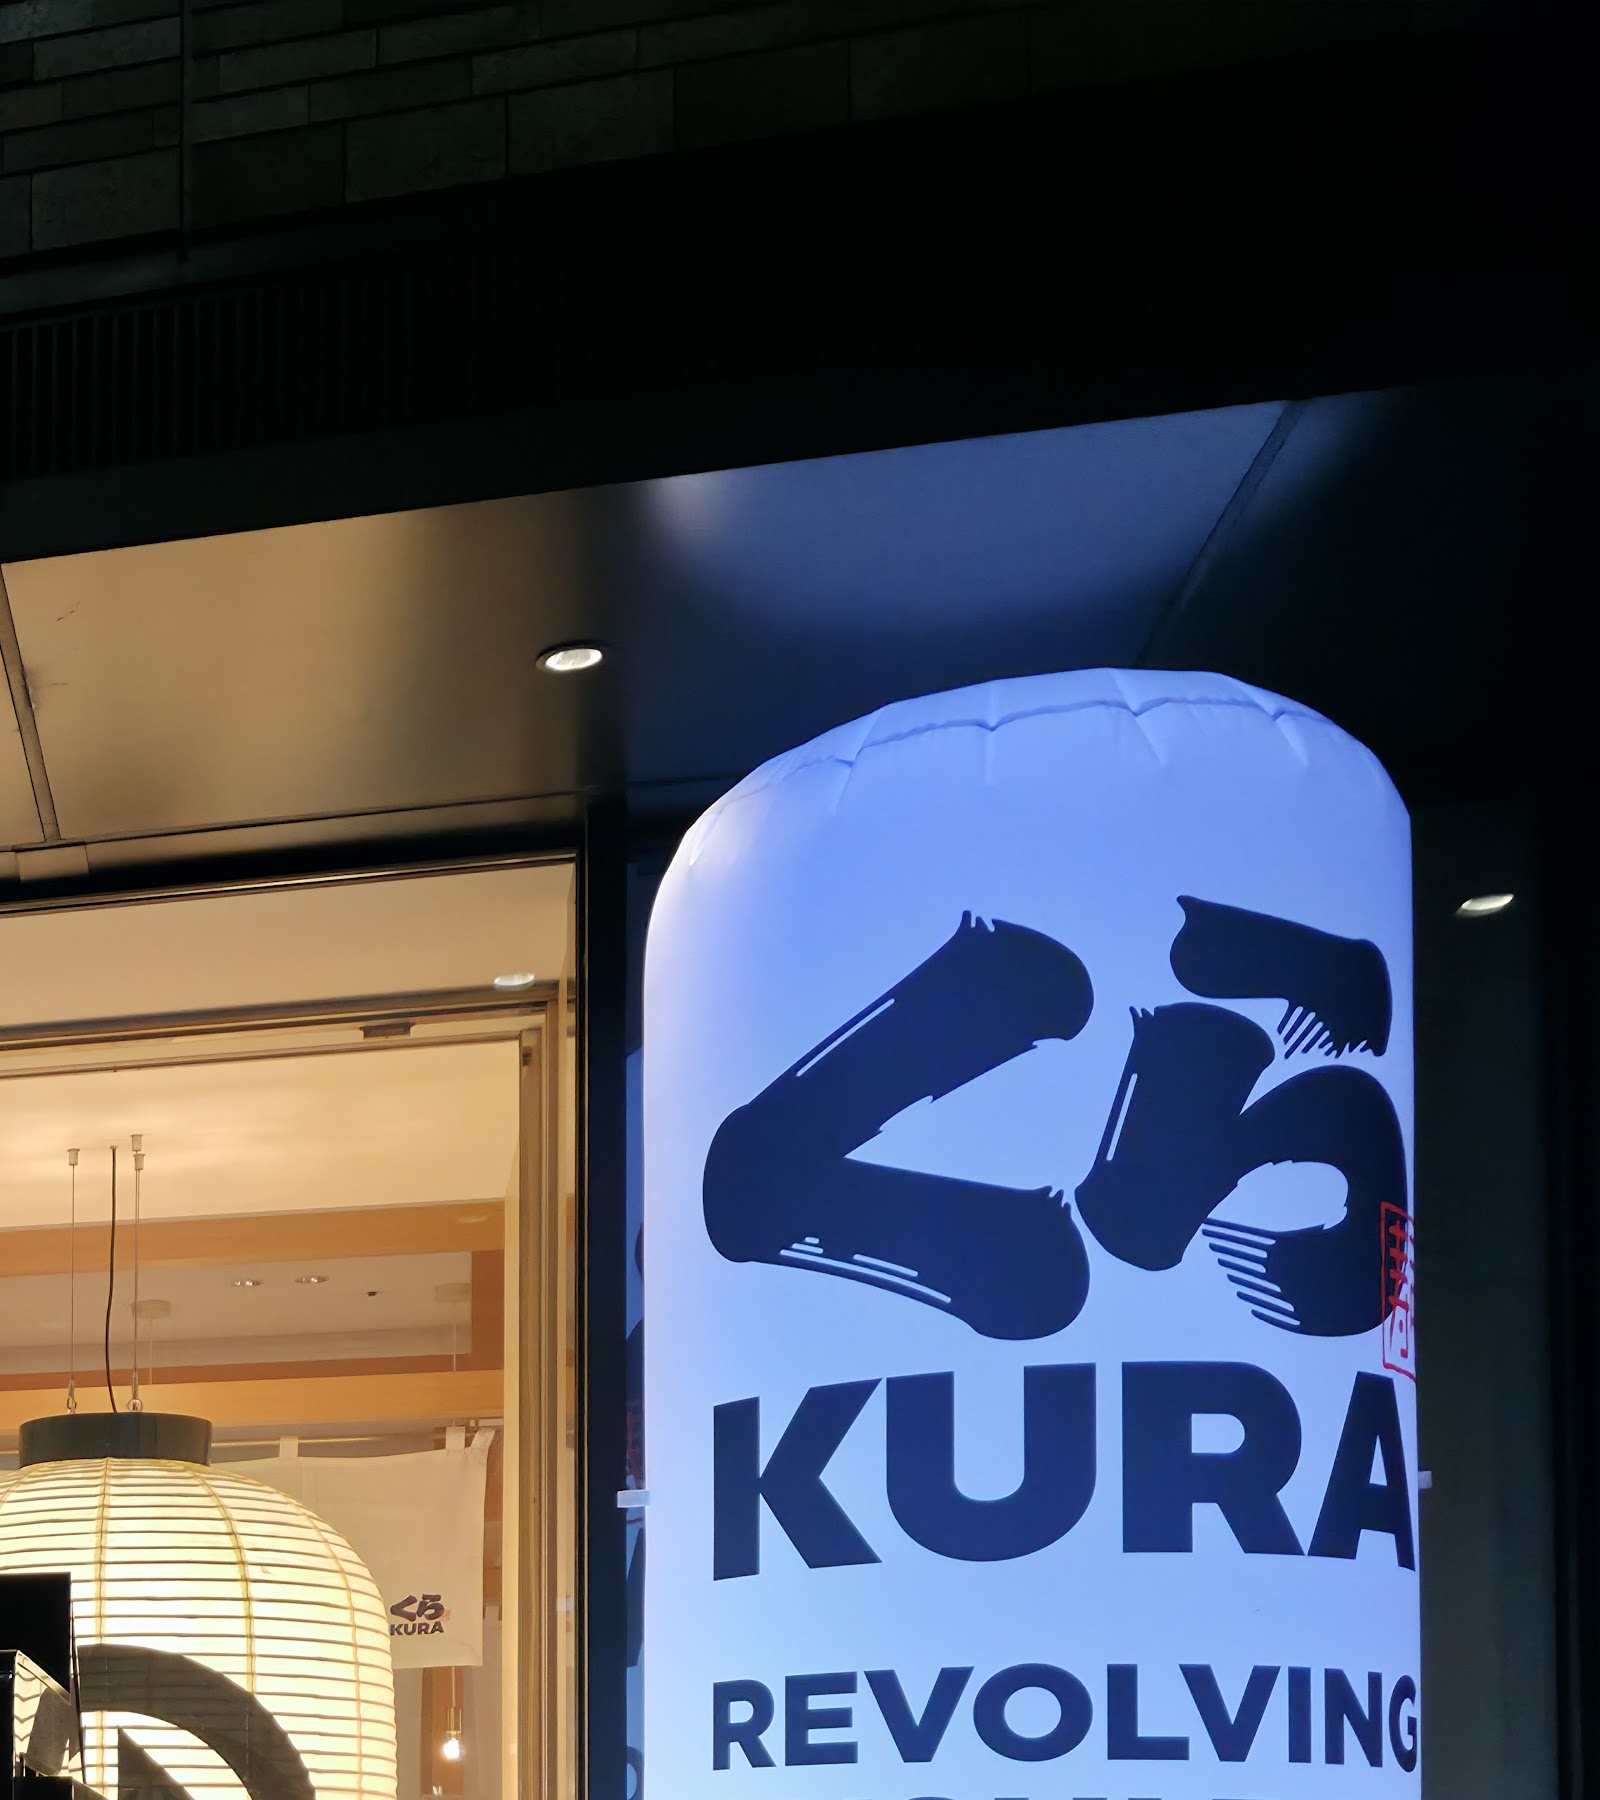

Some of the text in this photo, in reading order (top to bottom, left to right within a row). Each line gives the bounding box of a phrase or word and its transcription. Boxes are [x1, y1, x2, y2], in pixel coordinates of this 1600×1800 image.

[703, 895, 1409, 1340] くら
[713, 1361, 1414, 1581] KURA
[390, 1594, 445, 1622] くら
[390, 1621, 445, 1636] KURA
[712, 1663, 1417, 1773] REVOLVING
